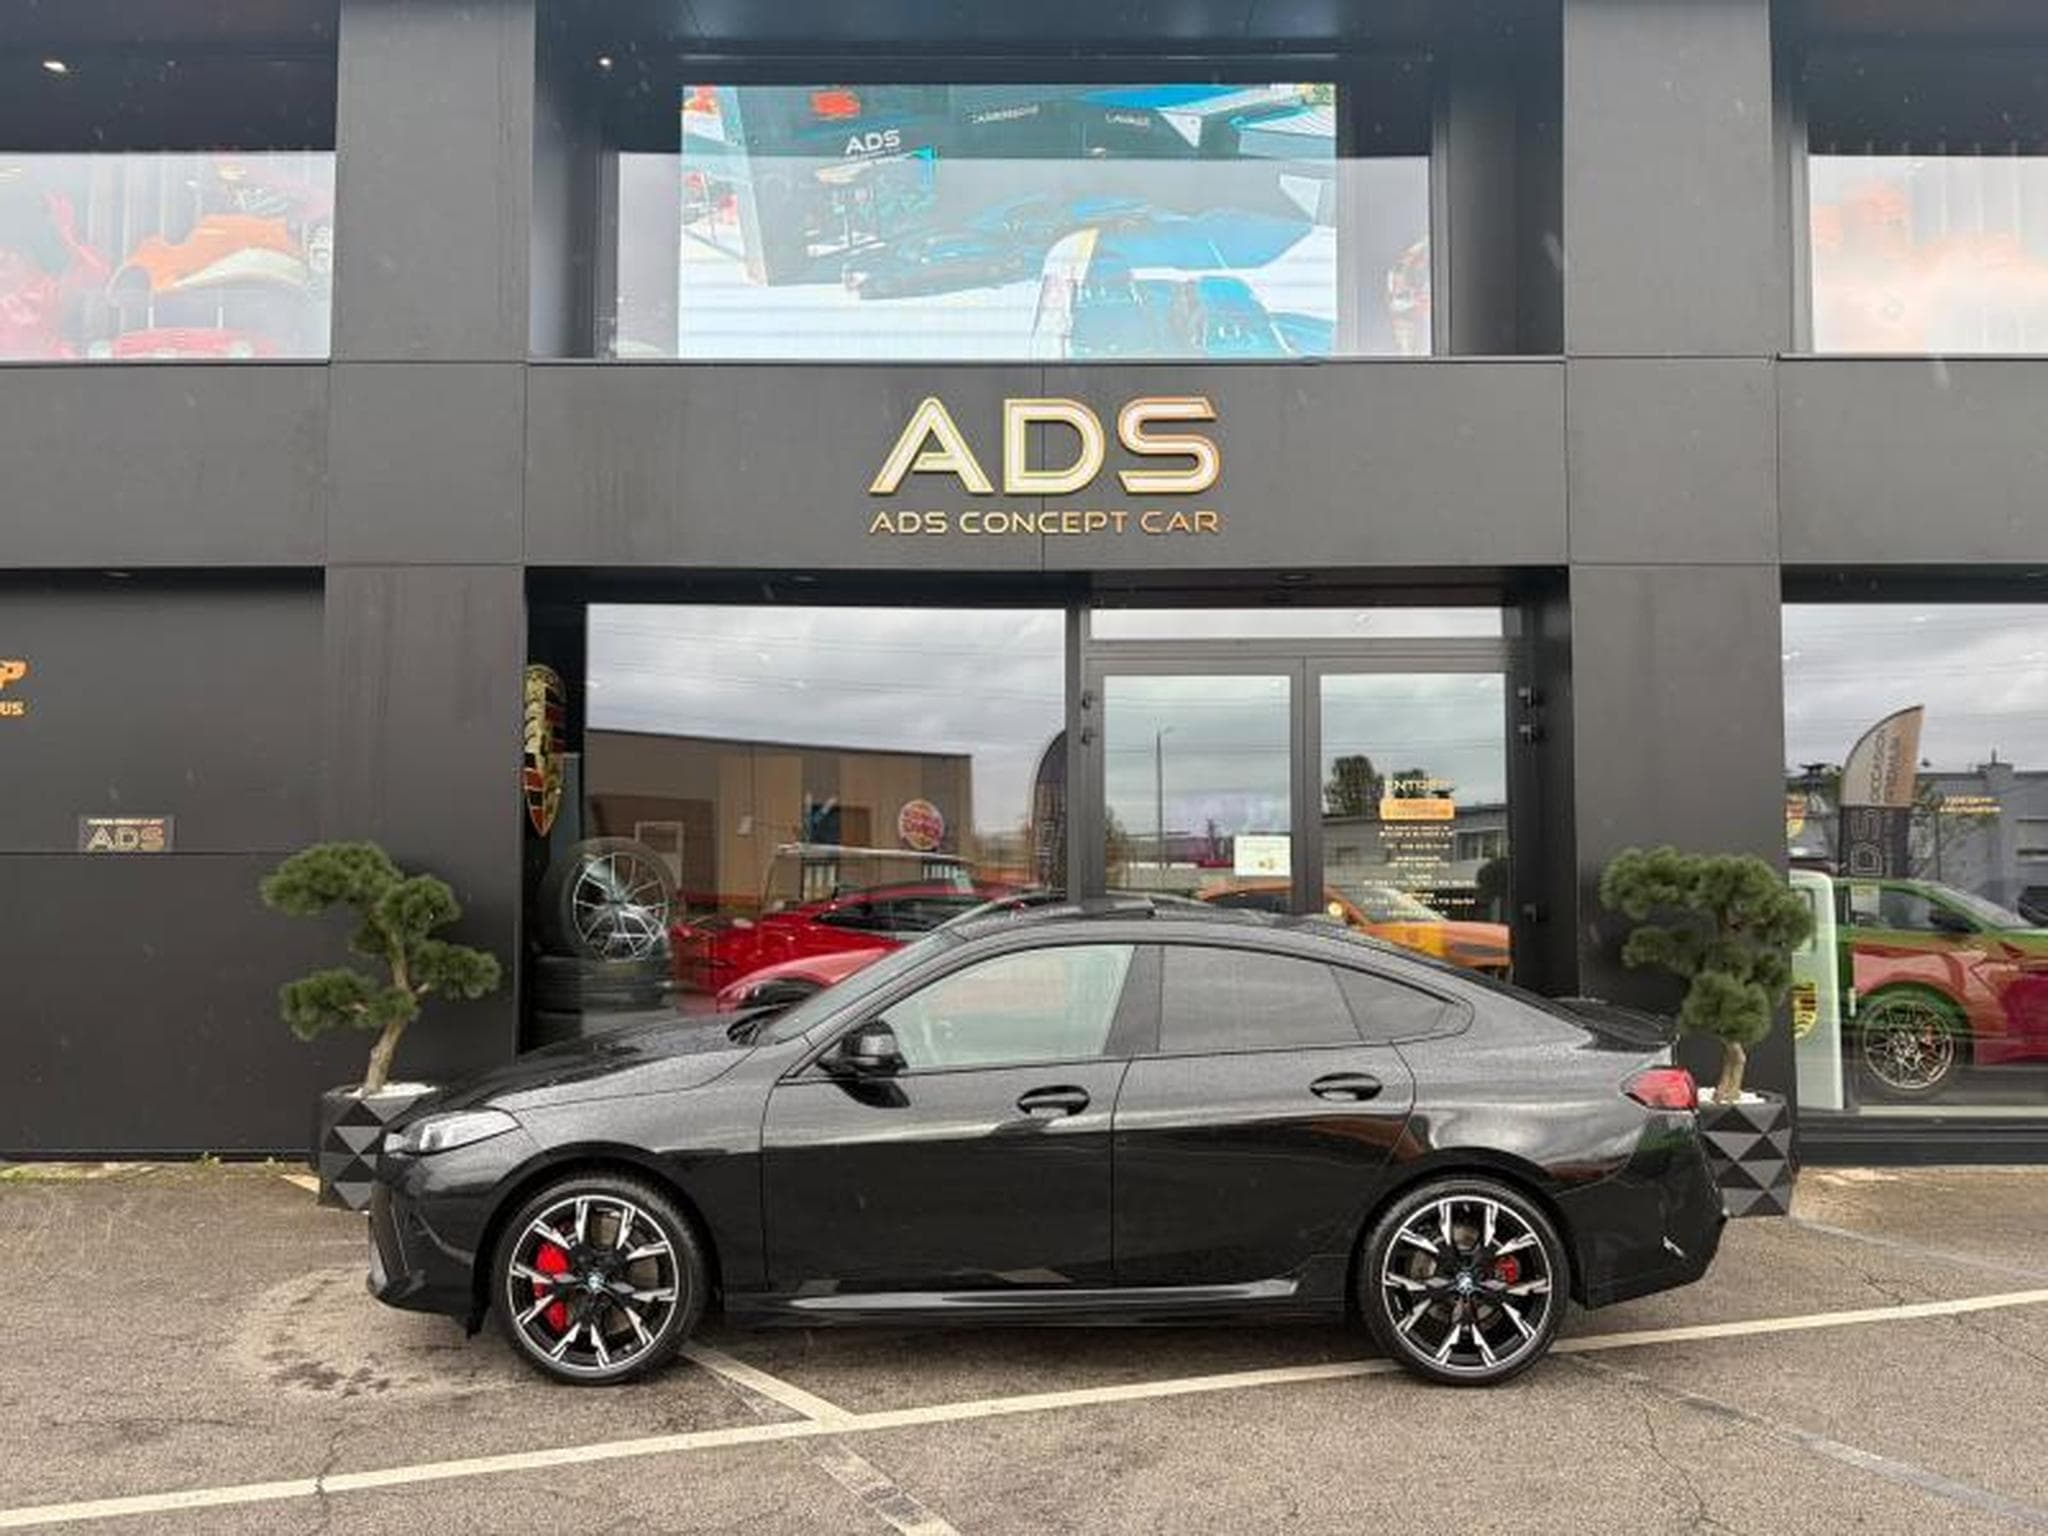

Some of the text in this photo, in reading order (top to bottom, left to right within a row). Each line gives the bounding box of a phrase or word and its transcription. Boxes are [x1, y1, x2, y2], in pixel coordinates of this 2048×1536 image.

[846, 129, 900, 154] ADS
[868, 396, 1221, 494] ADS
[869, 511, 1220, 534] ADS CONCEPT CAR
[86, 826, 165, 852] ADS
